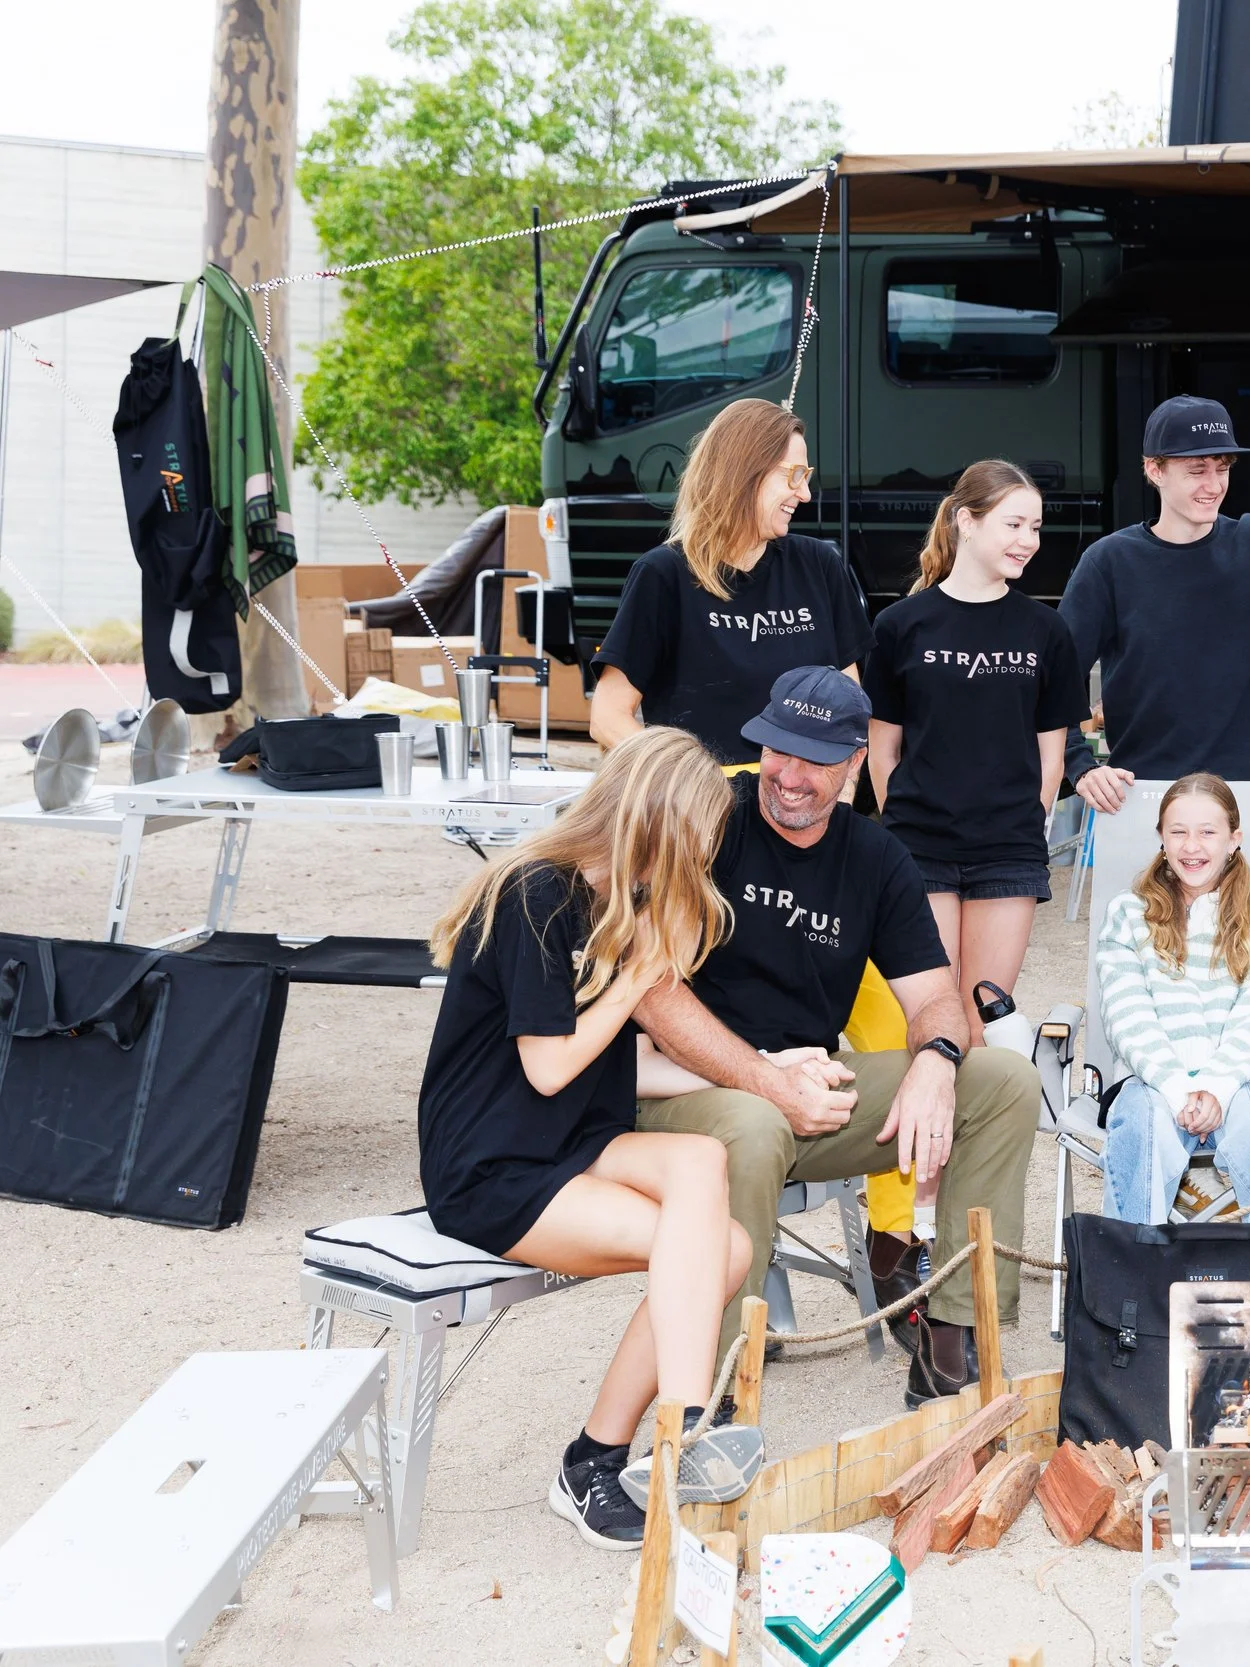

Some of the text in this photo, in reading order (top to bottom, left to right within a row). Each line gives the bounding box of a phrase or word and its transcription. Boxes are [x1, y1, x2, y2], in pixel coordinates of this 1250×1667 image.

[1191, 422, 1228, 435] STRATUS
[160, 442, 191, 513] STRATUS
[708, 607, 813, 642] STRATUS
[759, 623, 816, 636] OUTDOORS
[923, 649, 1038, 679] STRATUS
[977, 665, 1036, 677] OUTDOORS
[782, 698, 833, 718] STRATUS
[801, 711, 832, 722] OUTDOORS
[422, 807, 481, 822] STRATUS
[236, 1505, 279, 1579] PROTECT
[279, 1481, 299, 1519] THE
[298, 1416, 347, 1497] ADVENTURE
[682, 1547, 728, 1597] CAUTION
[686, 1580, 713, 1621] HOT
